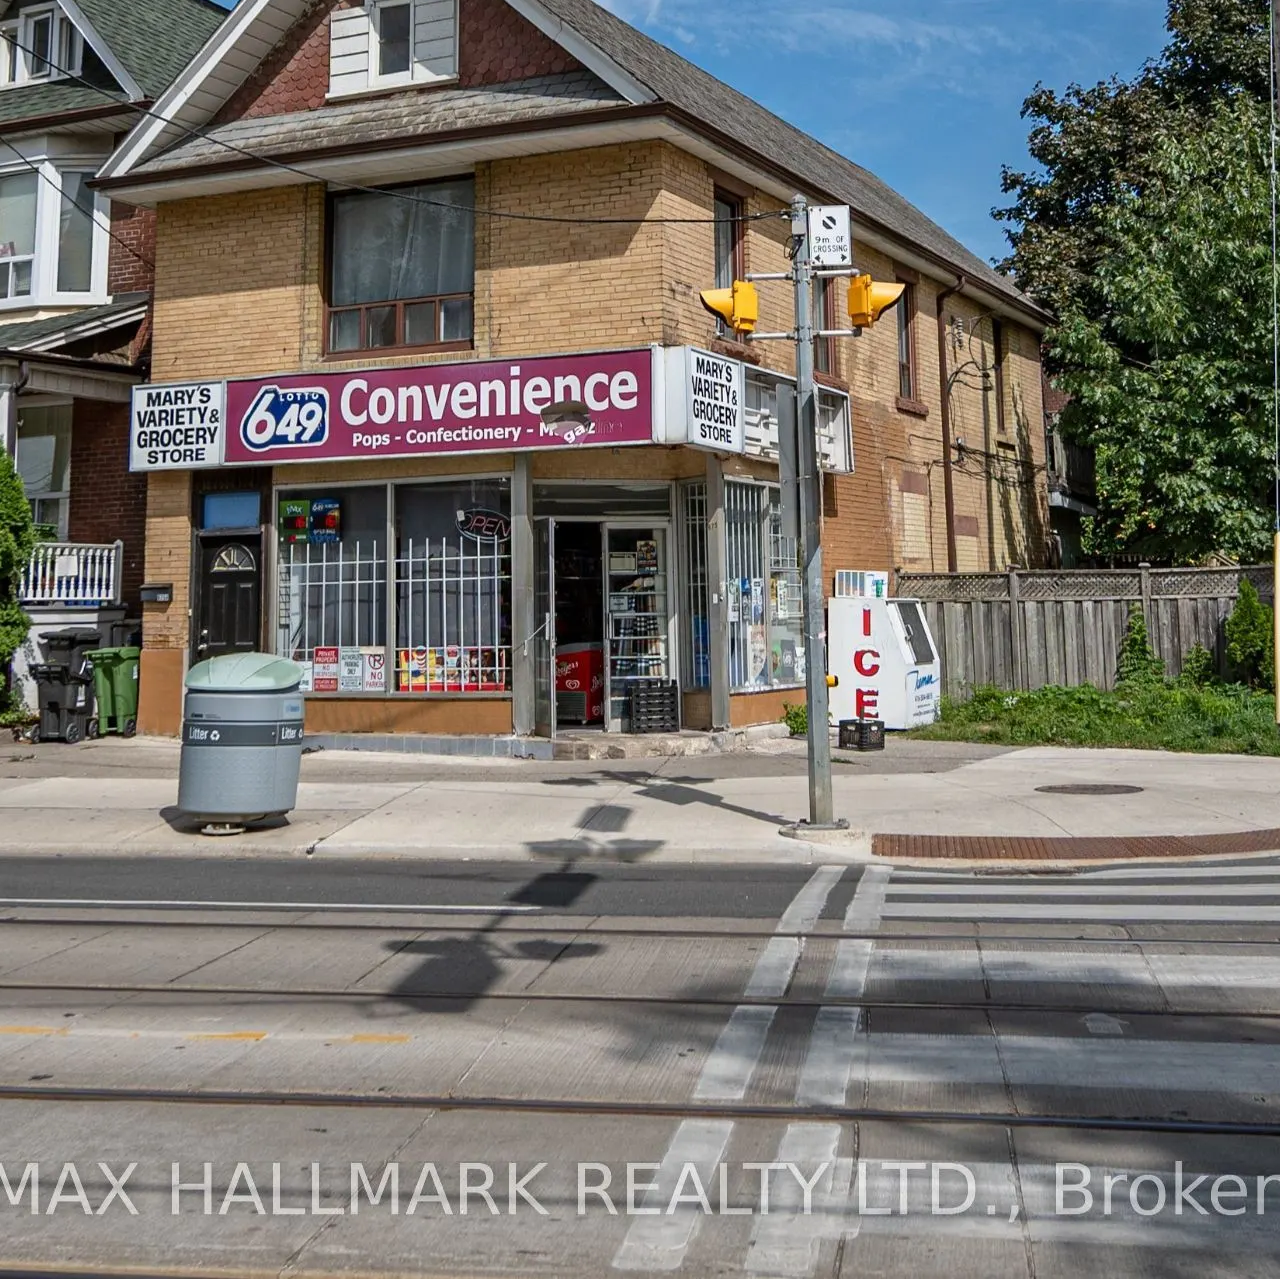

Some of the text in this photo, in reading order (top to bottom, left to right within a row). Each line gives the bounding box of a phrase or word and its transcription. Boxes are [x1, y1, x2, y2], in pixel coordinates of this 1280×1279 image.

[696, 357, 732, 383] MARY'S
[146, 386, 211, 408] MARY'S
[279, 392, 319, 402] LOTTO
[341, 366, 638, 426] Convenience
[692, 375, 737, 405] VARIETY &
[137, 407, 219, 428] VARIETY &
[693, 399, 737, 427] GROCERY
[137, 427, 218, 449] GROCERY
[352, 430, 390, 449] Pops
[406, 425, 521, 444] Confectionery
[700, 423, 732, 444] STORE
[147, 447, 206, 464] STORE
[458, 513, 511, 537] OPEN
[854, 608, 881, 719] ICE
[371, 672, 382, 680] NO
[189, 727, 209, 740] Litter
[281, 727, 296, 739] Litter
